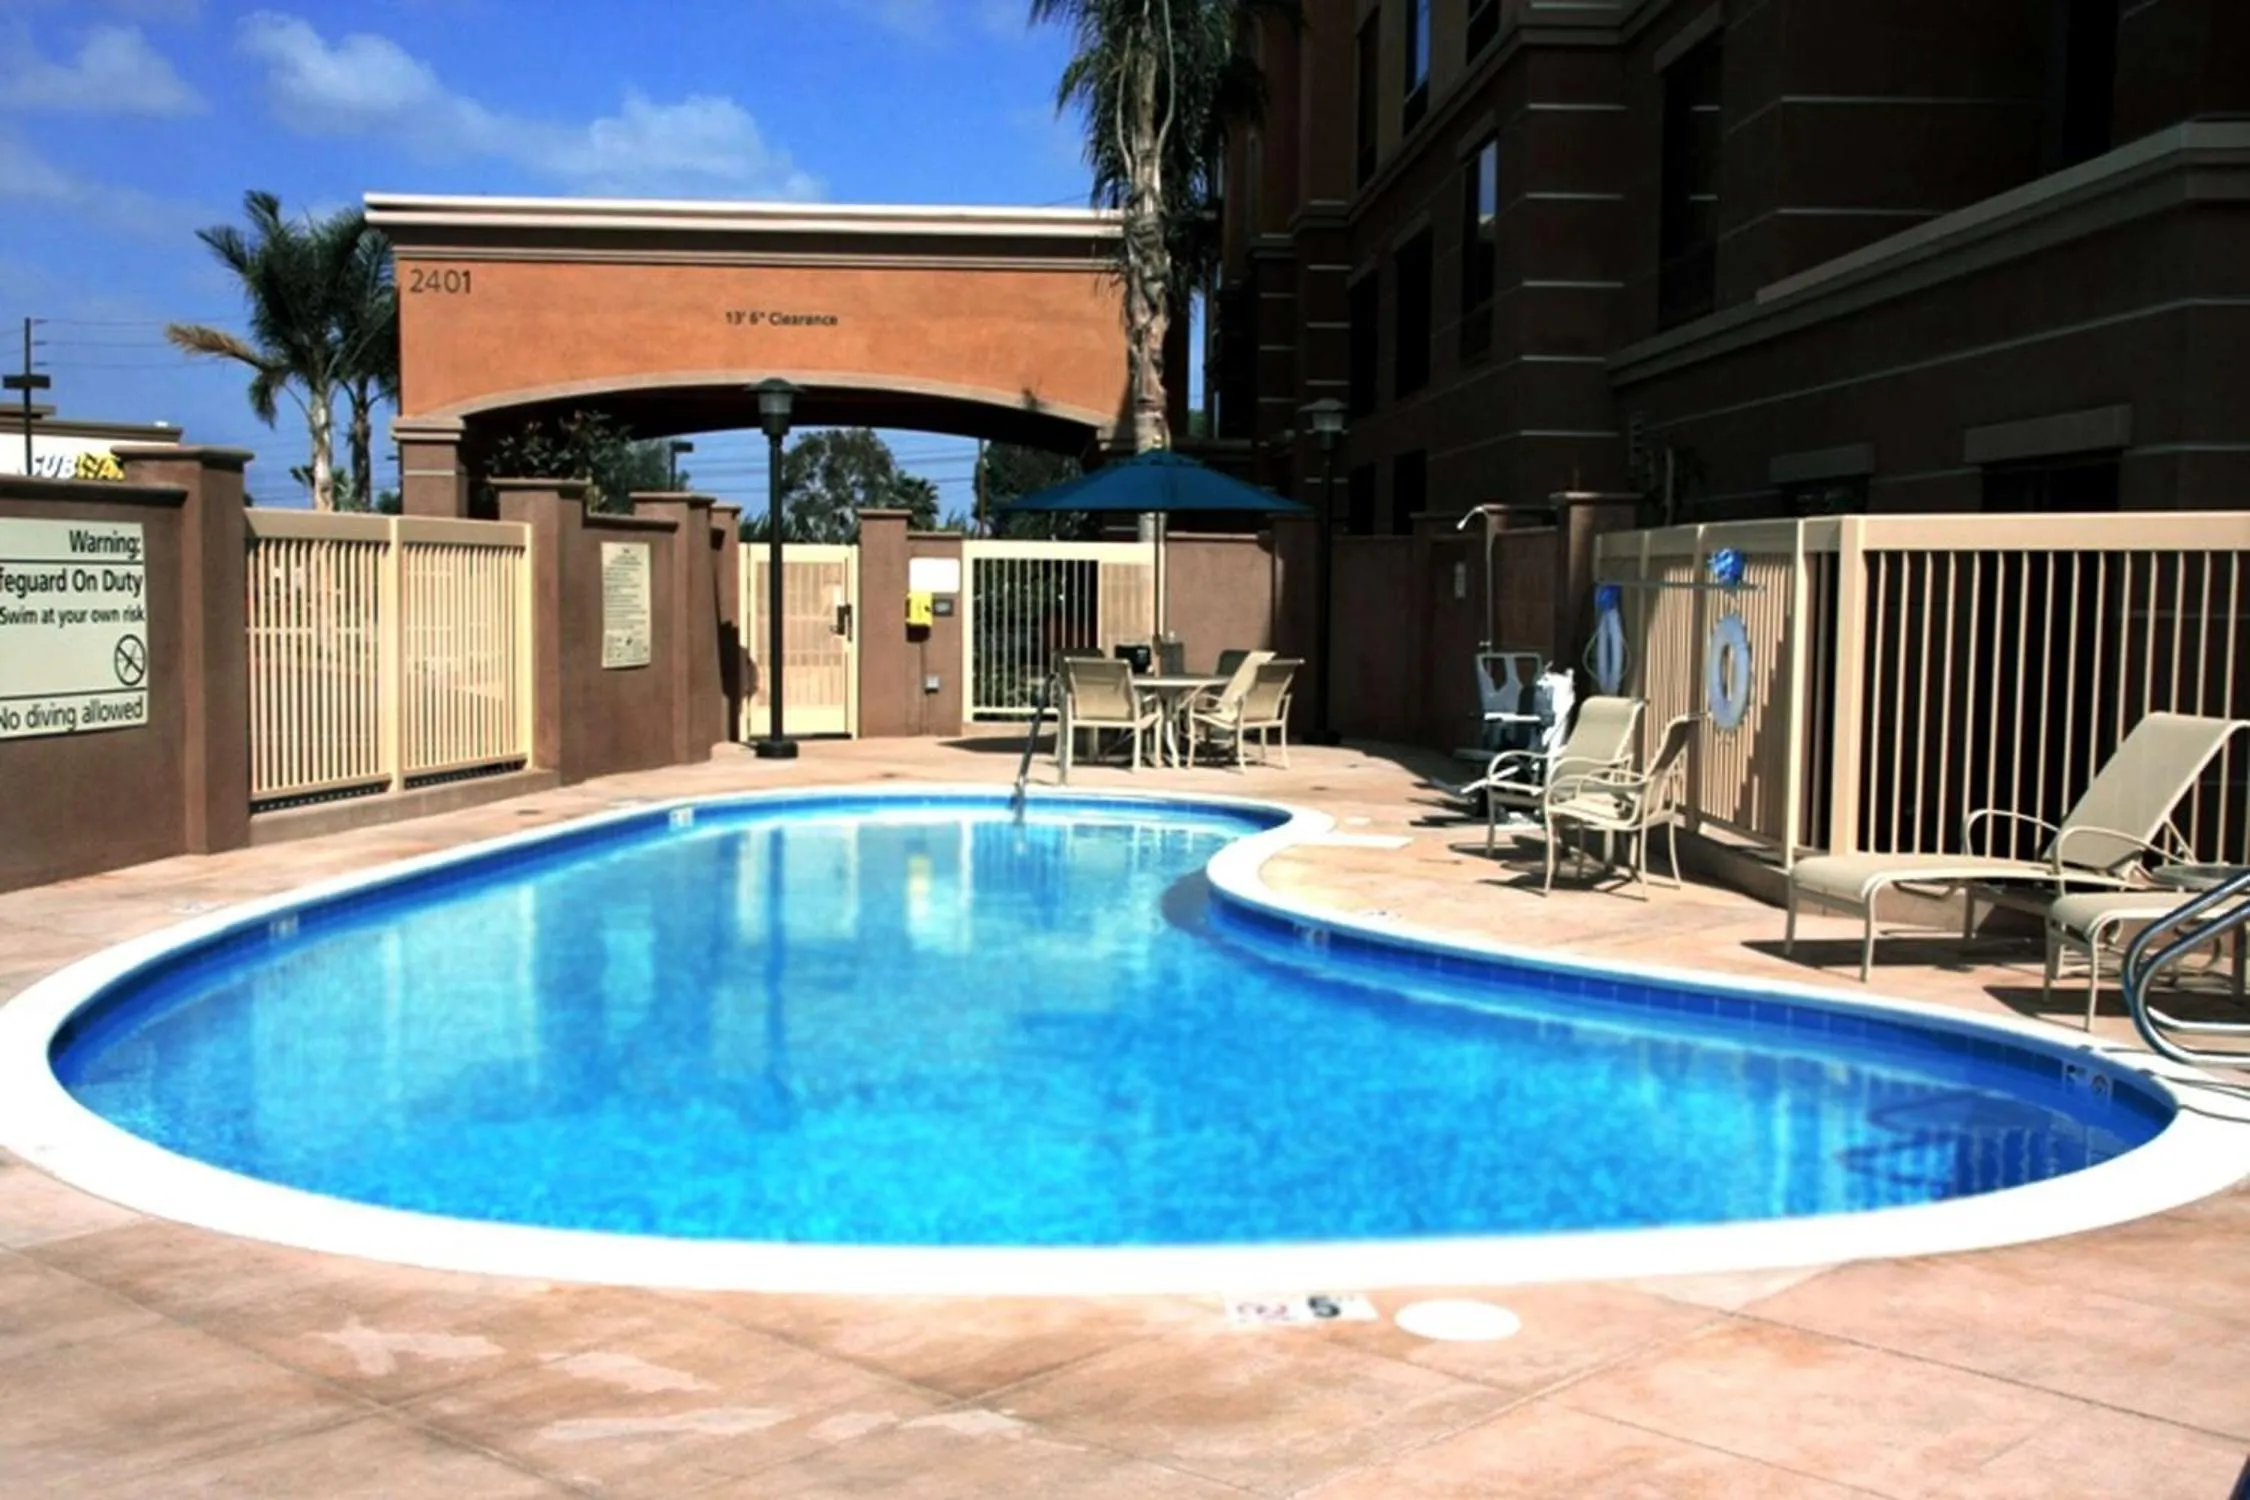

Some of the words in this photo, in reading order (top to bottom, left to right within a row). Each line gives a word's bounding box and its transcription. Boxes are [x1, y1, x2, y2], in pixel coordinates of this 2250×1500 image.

[410, 268, 471, 294] 2401
[768, 311, 838, 326] Clearance
[69, 529, 141, 560] Warning:
[72, 568, 98, 592] On
[102, 568, 143, 598] Duty
[0, 605, 38, 625] Swim
[41, 608, 55, 624] at
[58, 608, 87, 629] your
[90, 609, 119, 622] own
[123, 604, 145, 621] risk
[26, 702, 77, 732] diving
[82, 695, 143, 724] allowed
